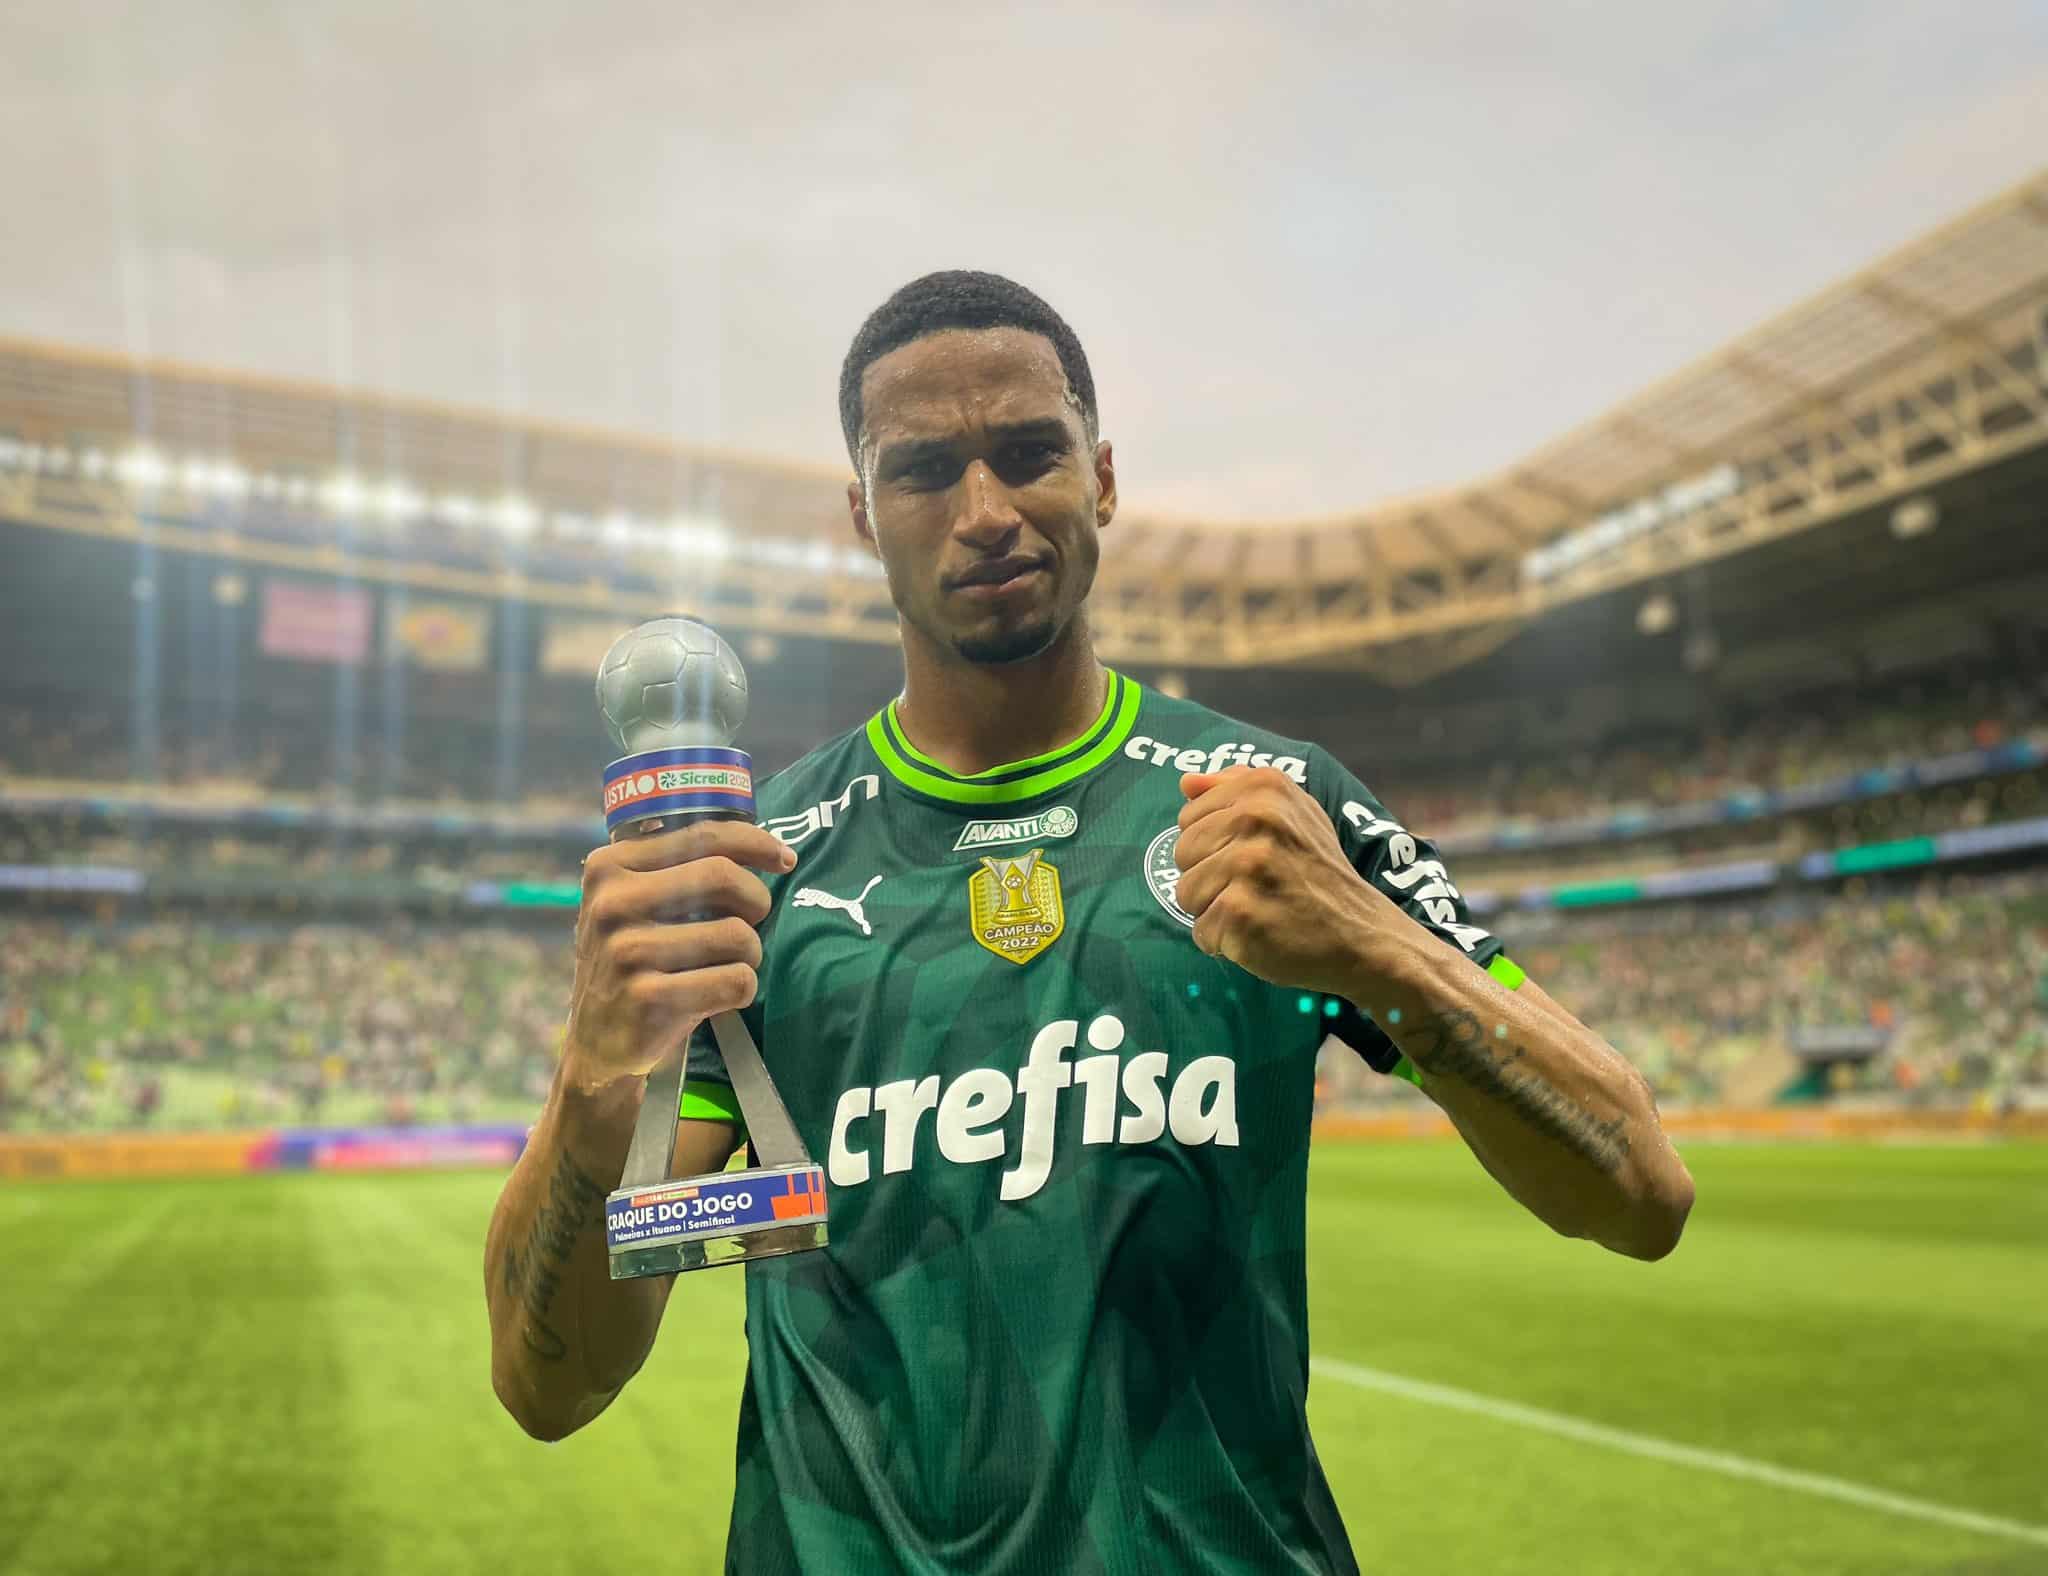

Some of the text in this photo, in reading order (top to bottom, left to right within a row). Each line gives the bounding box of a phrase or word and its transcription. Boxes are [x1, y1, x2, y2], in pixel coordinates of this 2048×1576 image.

[1124, 736, 1307, 783] crefisa
[679, 771, 728, 785] Sicredi
[964, 820, 1038, 844] AVANTI
[1342, 801, 1490, 953] crefisa
[1002, 936, 1039, 949] 2022
[828, 1014, 1240, 1201] crefisa
[608, 1206, 655, 1231] CRAQUE
[658, 1201, 688, 1221] DO
[692, 1192, 752, 1217] JOGO
[652, 1222, 682, 1235] Ituano
[688, 1214, 736, 1230] Semifinal
